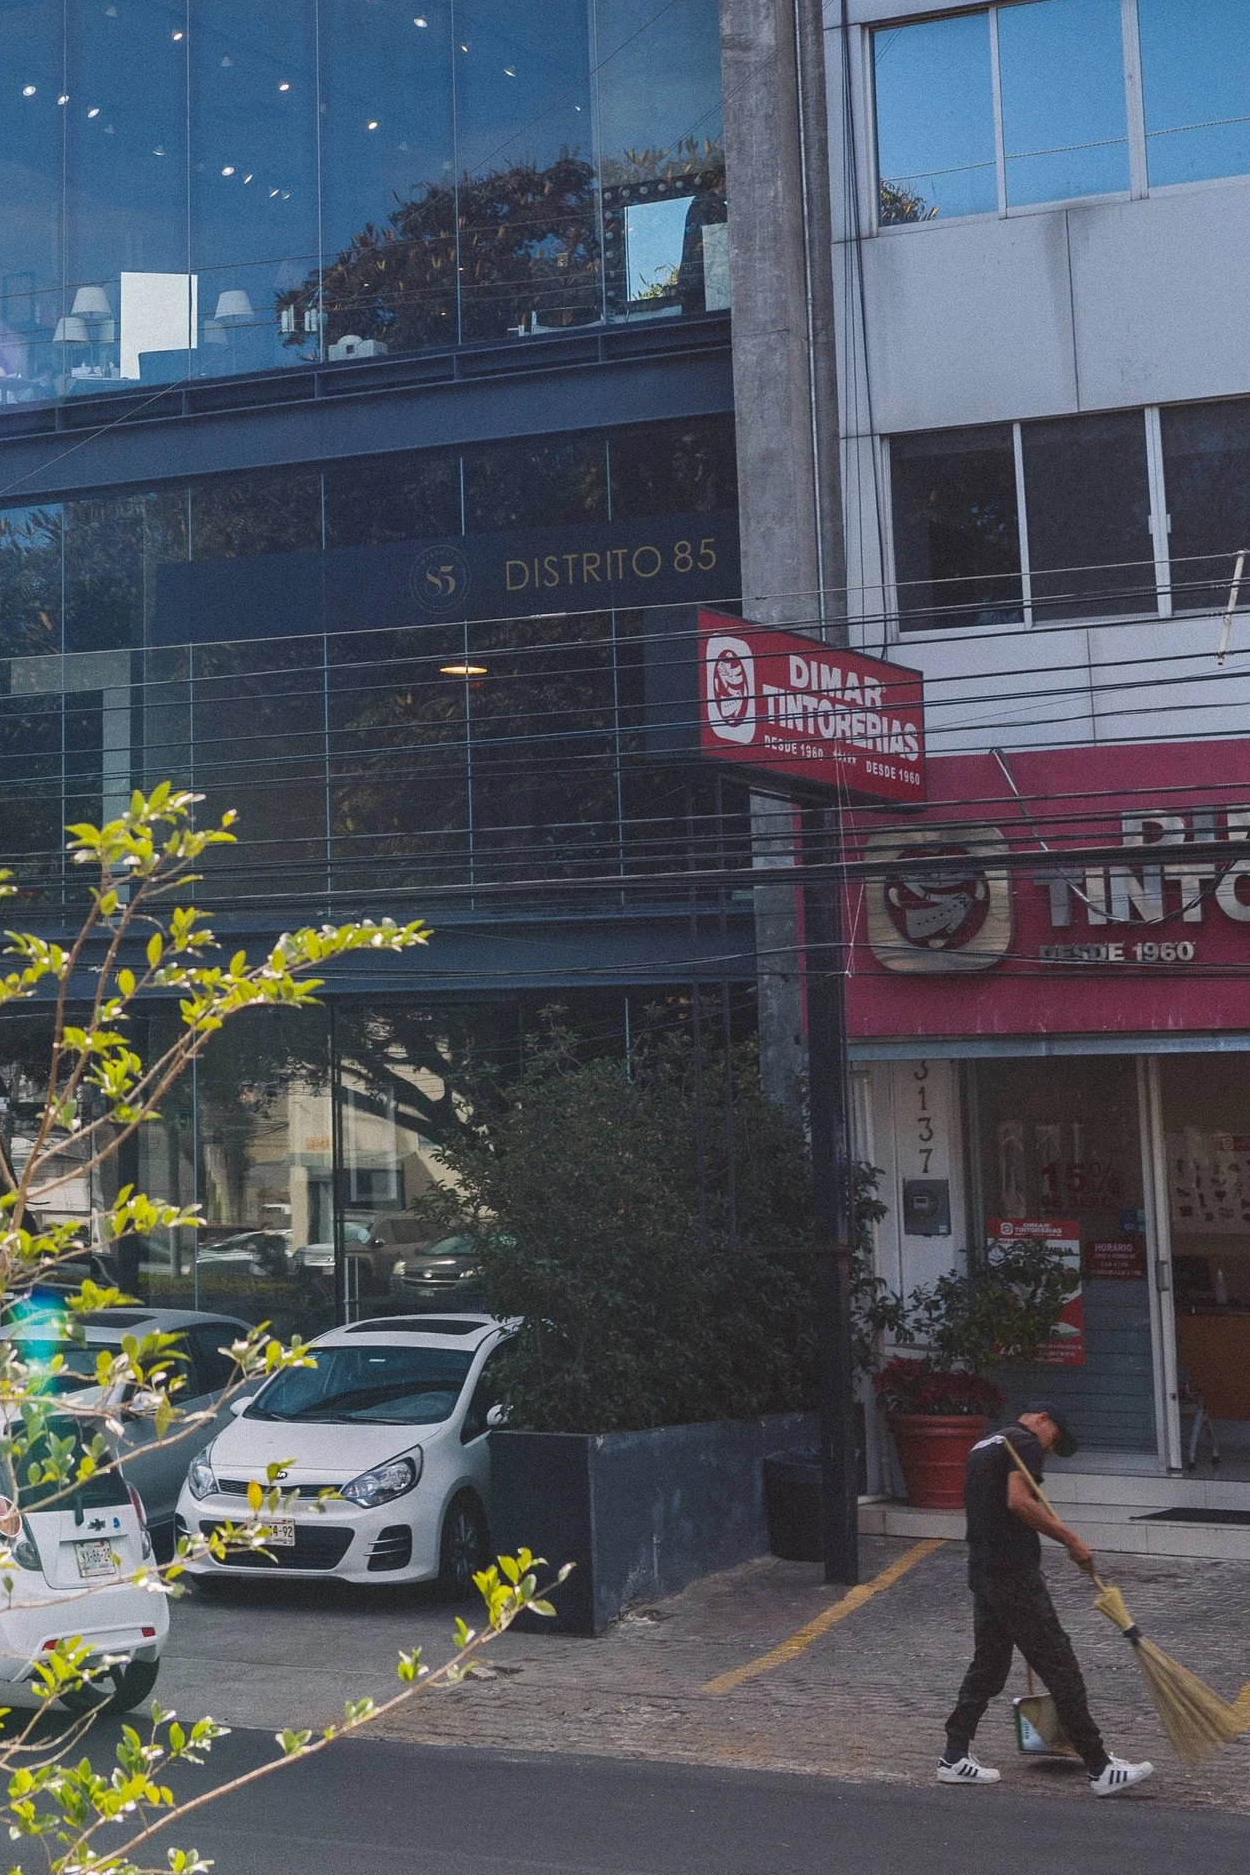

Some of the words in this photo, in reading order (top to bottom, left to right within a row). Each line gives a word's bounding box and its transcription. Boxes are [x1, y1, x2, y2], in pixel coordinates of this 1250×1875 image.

[506, 546, 661, 591] DISTRITO
[674, 539, 716, 572] 85
[789, 655, 882, 709] DIMAR
[762, 683, 919, 762] TINTORERIAS
[764, 735, 797, 754] DESDE
[800, 744, 823, 761] 1960
[866, 760, 896, 779] DESDE
[899, 769, 920, 785] 1960
[1039, 942, 1125, 961] DESDE
[1132, 941, 1195, 961] 1960
